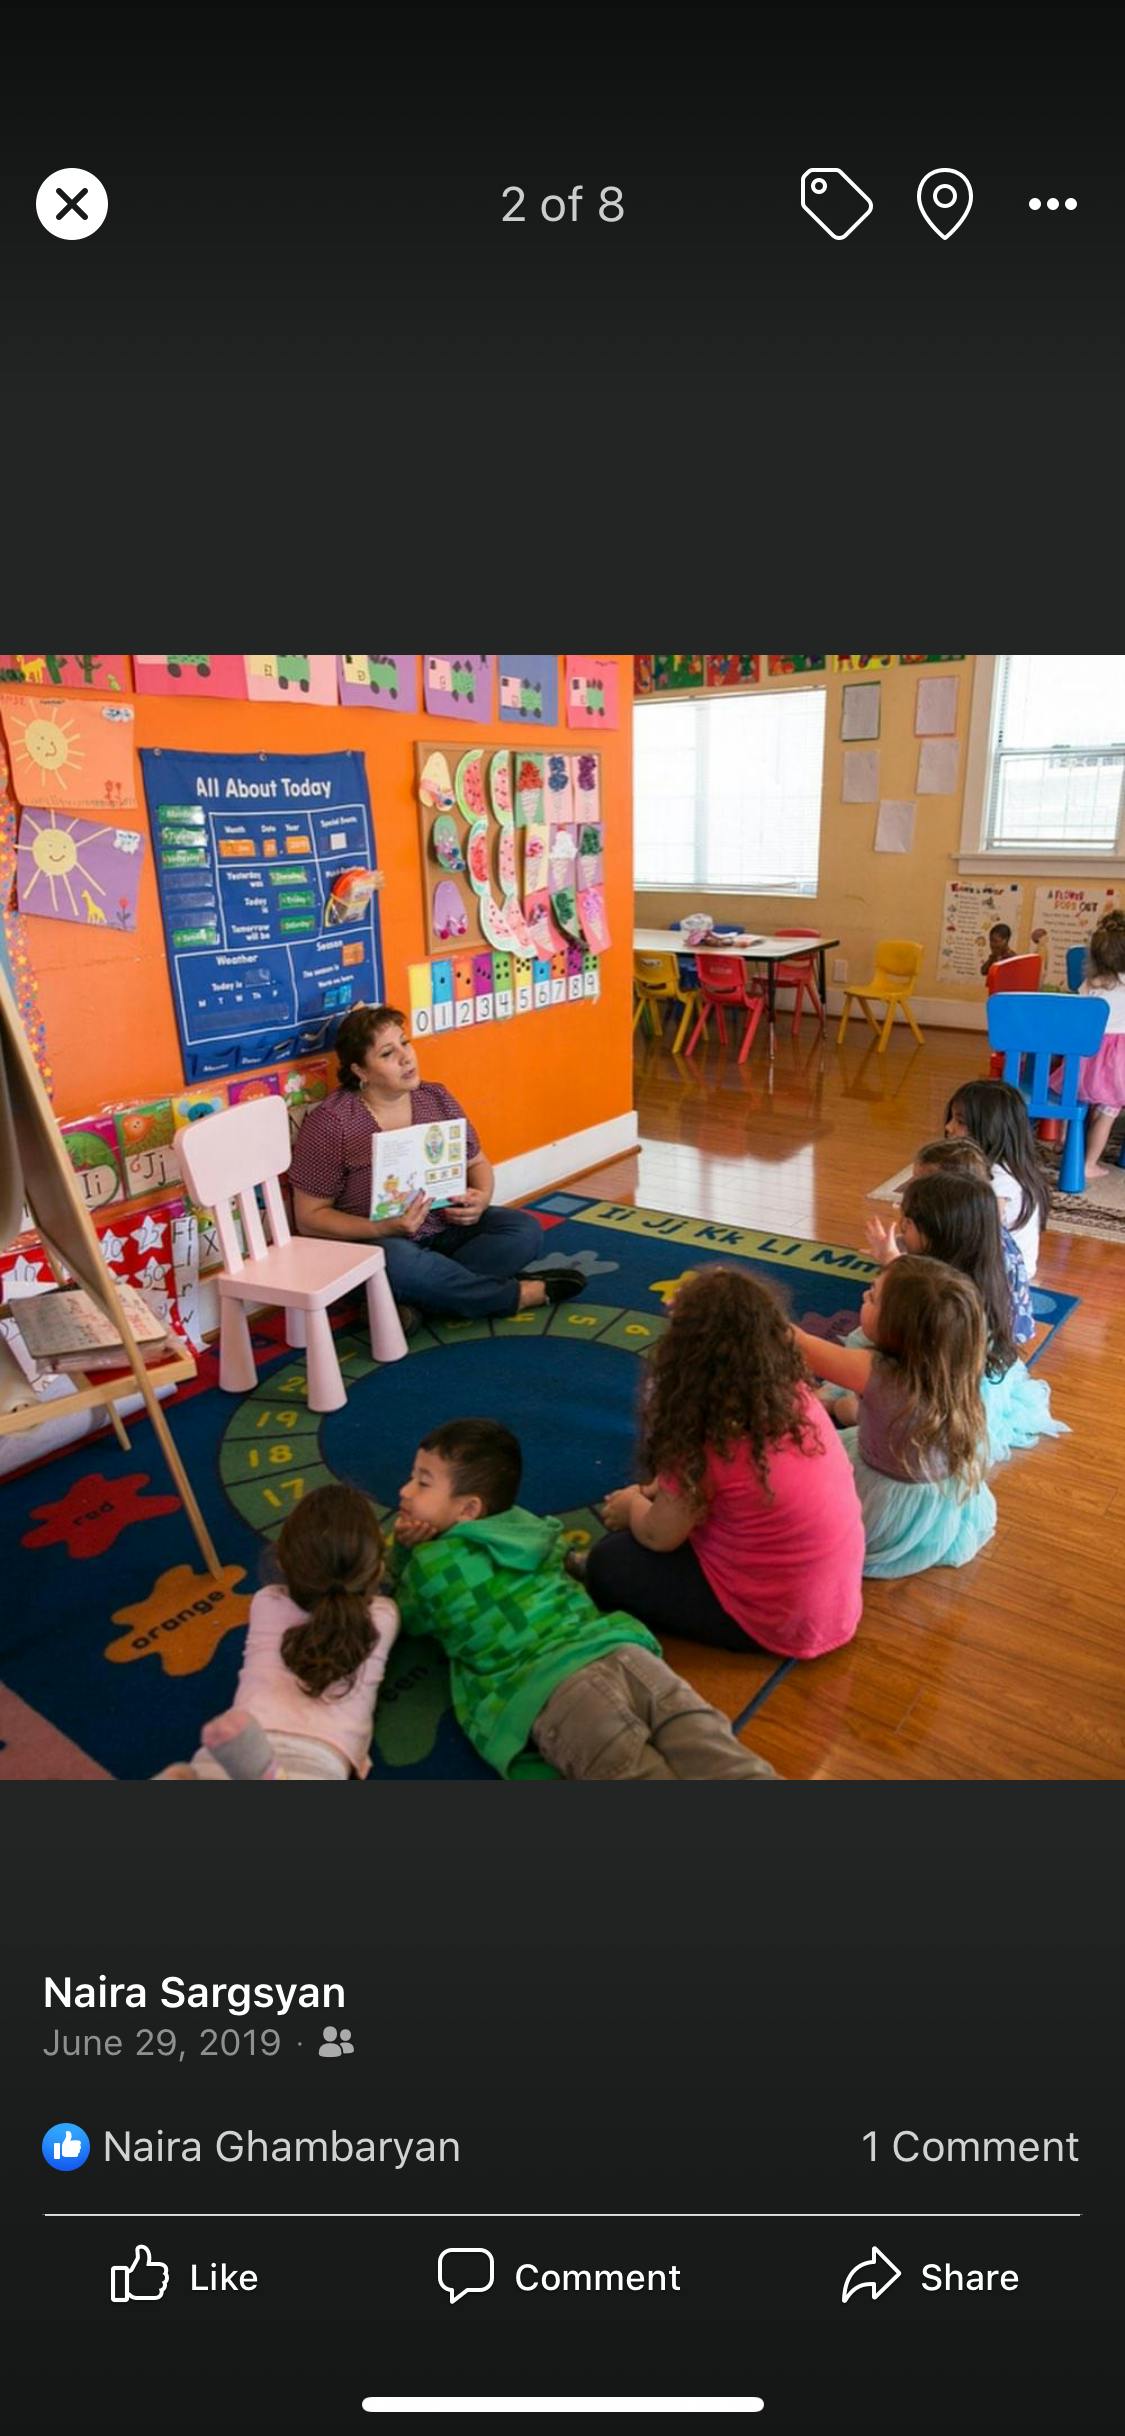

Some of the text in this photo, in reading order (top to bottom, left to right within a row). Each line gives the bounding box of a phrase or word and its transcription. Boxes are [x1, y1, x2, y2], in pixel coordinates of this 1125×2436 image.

[196, 777, 331, 799] All About Today
[216, 953, 259, 966] Weather
[416, 1010, 429, 1032] 0
[441, 1005, 446, 1026] 1
[460, 1002, 470, 1024] 2
[480, 997, 489, 1018] 3
[500, 993, 509, 1013] 4
[519, 988, 528, 1009] 5
[538, 984, 547, 1004] 6
[556, 981, 565, 1000] 7
[572, 978, 580, 997] 8
[81, 1152, 166, 1199] Ii Jj
[597, 1206, 636, 1222] Ii
[642, 1217, 688, 1235] Jj
[694, 1225, 745, 1245] Kk
[568, 1313, 598, 1327] 5
[256, 1410, 299, 1429] 19
[248, 1444, 294, 1468] 18
[262, 1478, 305, 1508] 17
[72, 1502, 116, 1526] red
[131, 1589, 226, 1650] orange
